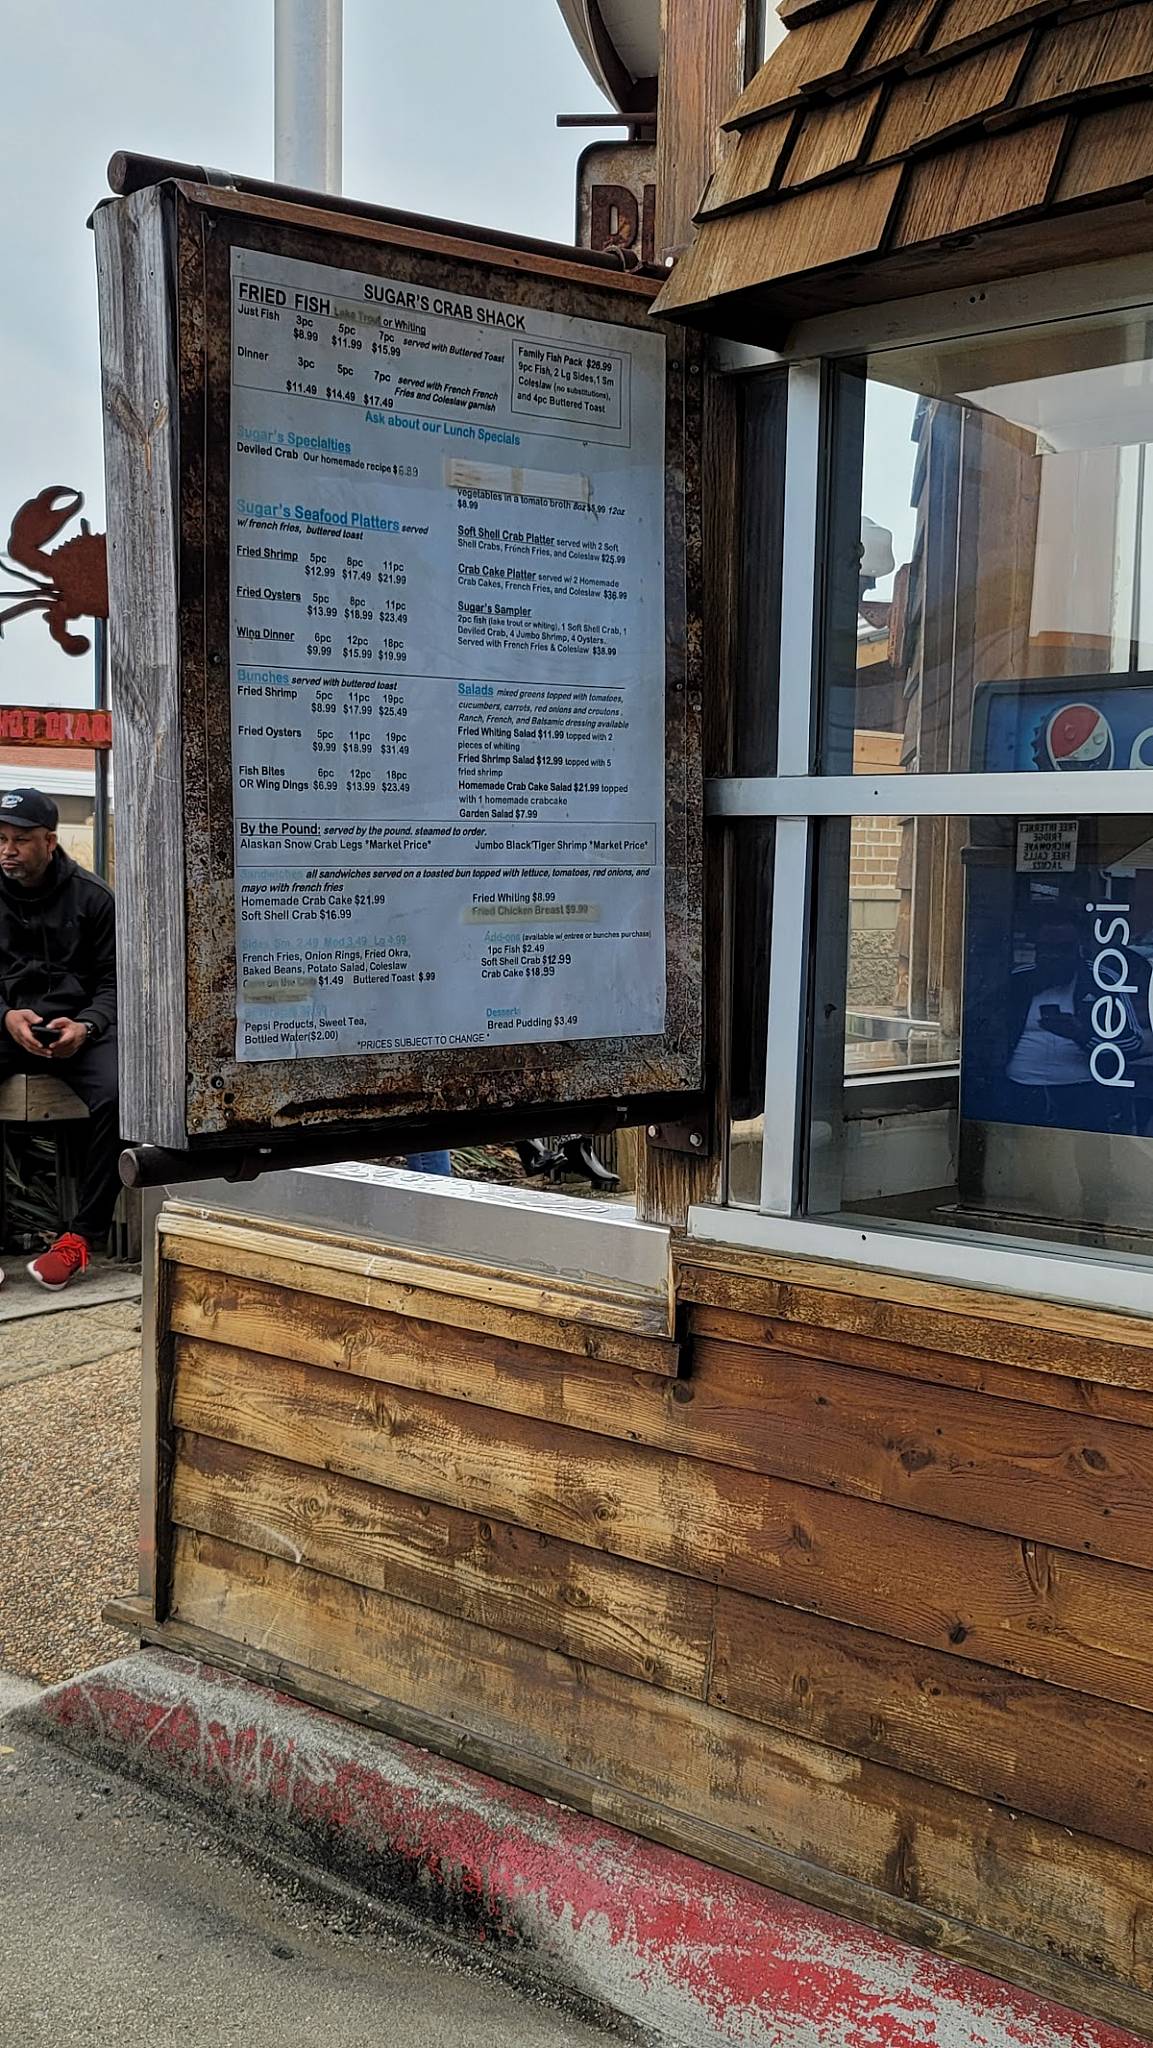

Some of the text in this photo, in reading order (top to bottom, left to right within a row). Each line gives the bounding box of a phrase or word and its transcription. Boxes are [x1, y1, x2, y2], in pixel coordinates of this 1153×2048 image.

[239, 283, 426, 336] FRIED FISH or Whiting
[364, 284, 526, 331] SUGAR'S CRAB SHACK
[238, 304, 505, 364] Just Fish 3pc 5pc 7pc served with Buttered Toast
[293, 328, 401, 358] $8.99 $11.99 $15.99
[519, 346, 544, 362] Family
[547, 352, 562, 364] Fish
[564, 355, 583, 367] Pack
[237, 346, 498, 401] Dinner 3pc 5pc 7pc served with French French
[286, 380, 394, 409] $11.49 $14.49 $17.49
[517, 390, 606, 414] and 4pc Buttered Toast
[366, 410, 520, 449] Ask about our Lunch Specials
[287, 432, 352, 455] Specialties
[237, 442, 392, 476] Deviled Crab Our homemade recipe
[237, 499, 429, 535] Sugar's Seafood Platters served
[458, 525, 555, 545] Soft Shell Crab Platter
[237, 546, 404, 573] Fried Shrimp 5pc 8pc 11pc
[305, 566, 407, 586] $12.99 $17.49 $21.99
[458, 563, 536, 581] Crab Cake Platter
[237, 586, 406, 612] Fried Oysters 5pc 8pc 11pc
[307, 606, 408, 624] $13.99 $18.99 $23.49
[458, 601, 532, 618] Sugar's Sampler
[237, 627, 404, 650] Wing Dinner 6pc 12pc 18pc
[307, 646, 407, 662] $9.99 $15.99 $19.99
[238, 669, 398, 691] Bunches served with buttered toast
[458, 683, 493, 695] Salads
[238, 686, 404, 705] Fried Shrimp 5pc 11pc 19pc
[311, 703, 408, 718] $8.99 $17.99 $25.49
[458, 726, 564, 740] Fried Whiting Salad $11.99
[240, 779, 410, 793] OR Wing Dings $6.99 $13.99 $23.49
[459, 809, 538, 819] Garden Salad $7.99
[240, 823, 256, 836] By
[259, 824, 278, 834] the
[281, 824, 321, 834] Pound:
[323, 826, 355, 835] served
[356, 827, 367, 837] by
[368, 826, 382, 835] the
[415, 827, 451, 836] steamed
[452, 828, 461, 836] to
[462, 828, 487, 836] order.
[240, 840, 282, 849] Alaskan
[284, 840, 312, 849] Snow
[314, 840, 338, 849] Crab
[340, 840, 363, 851] Legs
[242, 894, 385, 907] Homemade Crab Cake $21.99
[473, 892, 556, 904] Fried Whiting $8.99
[242, 948, 411, 963] French Fries, Onion Rings, Fried Okra,
[1086, 903, 1138, 1088] pepsi
[488, 1015, 578, 1030] Bread Pudding $3.49
[394, 1037, 433, 1048] SUBJECT
[433, 1036, 447, 1046] TO
[449, 1033, 485, 1045] CHANGE
